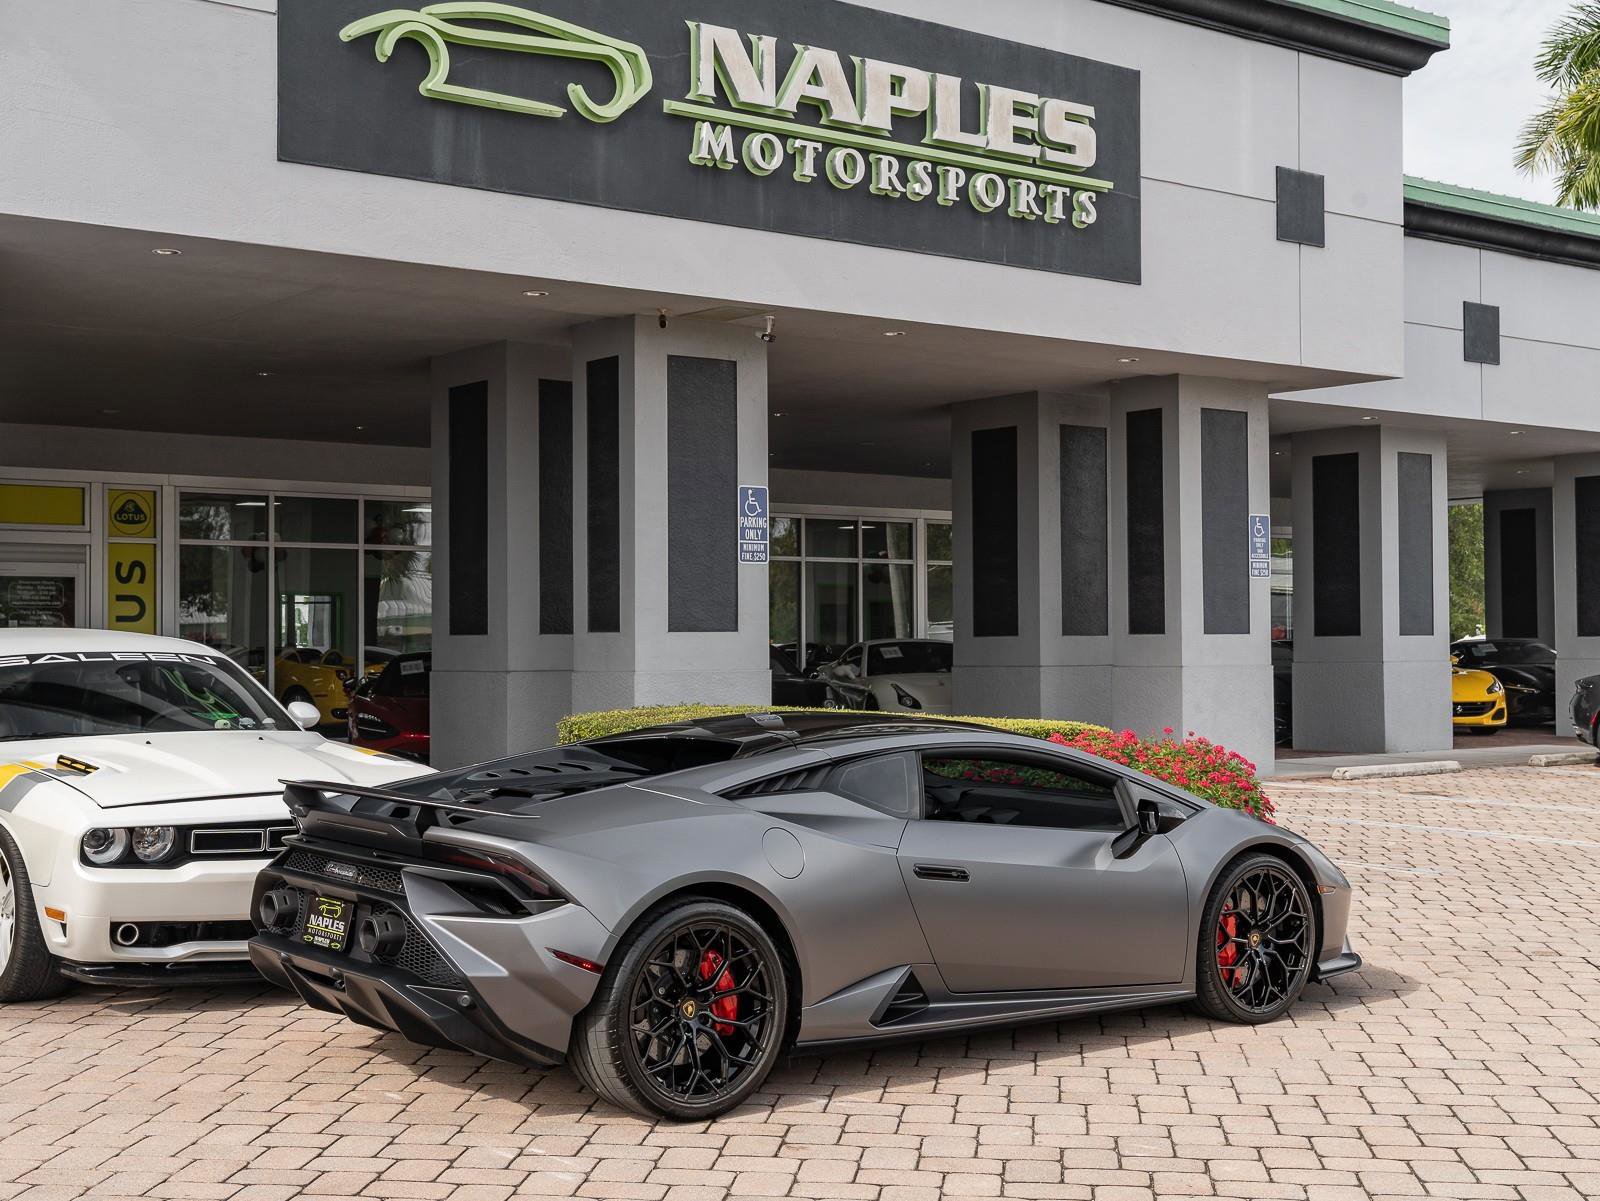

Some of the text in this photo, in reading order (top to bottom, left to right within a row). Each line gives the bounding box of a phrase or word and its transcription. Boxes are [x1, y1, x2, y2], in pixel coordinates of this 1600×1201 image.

[686, 20, 1097, 171] NAPLES
[689, 121, 1097, 228] MOTORSPORTS
[116, 513, 145, 521] LOTUS
[740, 517, 767, 528] PARKING
[745, 529, 762, 540] ONLY
[743, 544, 764, 552] MINIMUM
[741, 552, 766, 562] FINE $250
[0, 652, 217, 667] SALEEN
[309, 914, 345, 932] NAPLES
